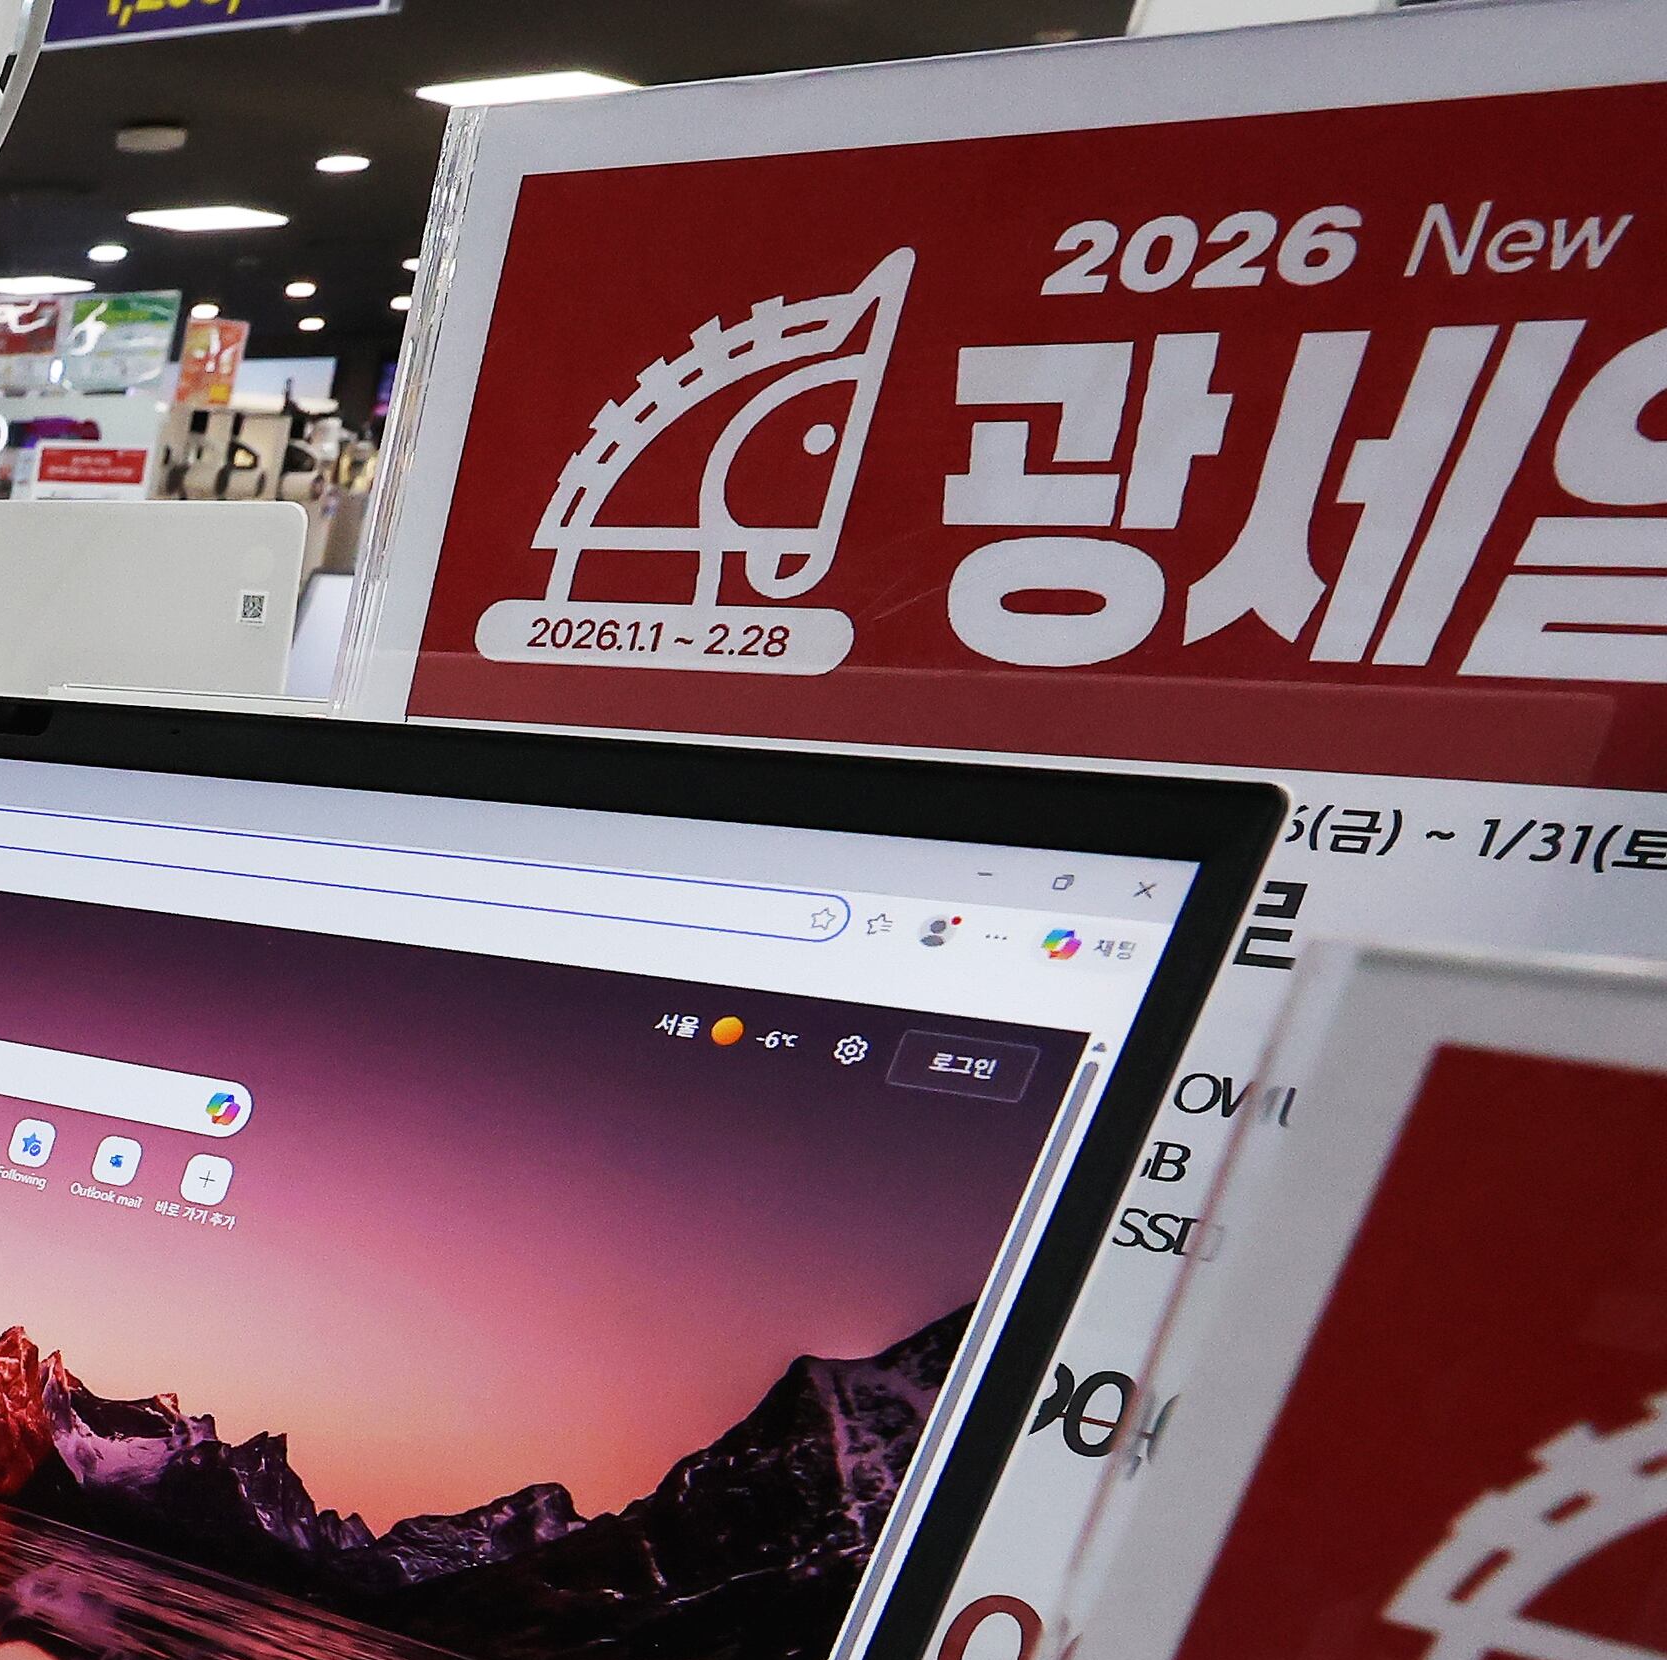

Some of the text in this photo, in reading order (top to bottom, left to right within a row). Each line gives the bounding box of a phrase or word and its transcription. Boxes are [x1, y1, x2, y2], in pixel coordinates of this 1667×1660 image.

[1040, 200, 1633, 296] 2026 New
[527, 617, 662, 655] 2026.1.1
[703, 622, 792, 660] 2.28
[654, 1012, 700, 1039] 서울
[928, 1051, 997, 1081] 로그인
[69, 1182, 143, 1210] Outlook mail
[154, 1199, 237, 1231] 바로 가기 추가
